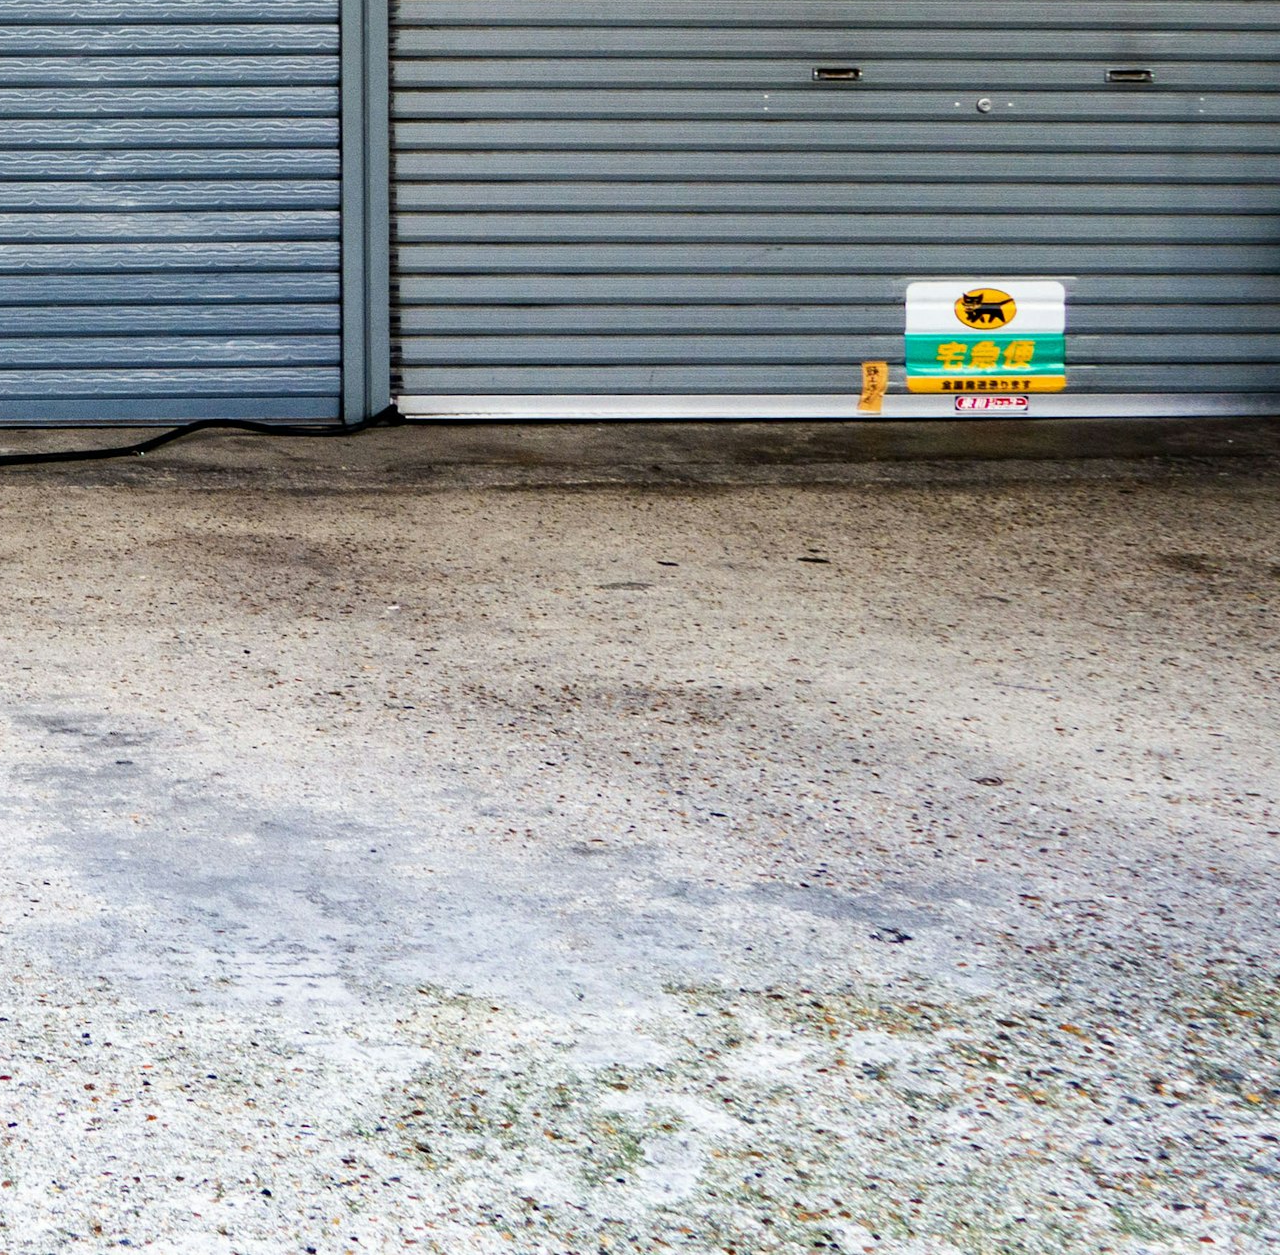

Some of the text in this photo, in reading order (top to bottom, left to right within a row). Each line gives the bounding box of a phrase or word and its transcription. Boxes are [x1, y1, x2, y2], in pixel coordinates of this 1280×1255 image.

[936, 340, 1036, 370] 宅急便
[941, 379, 1032, 391] 全国発送承ります
